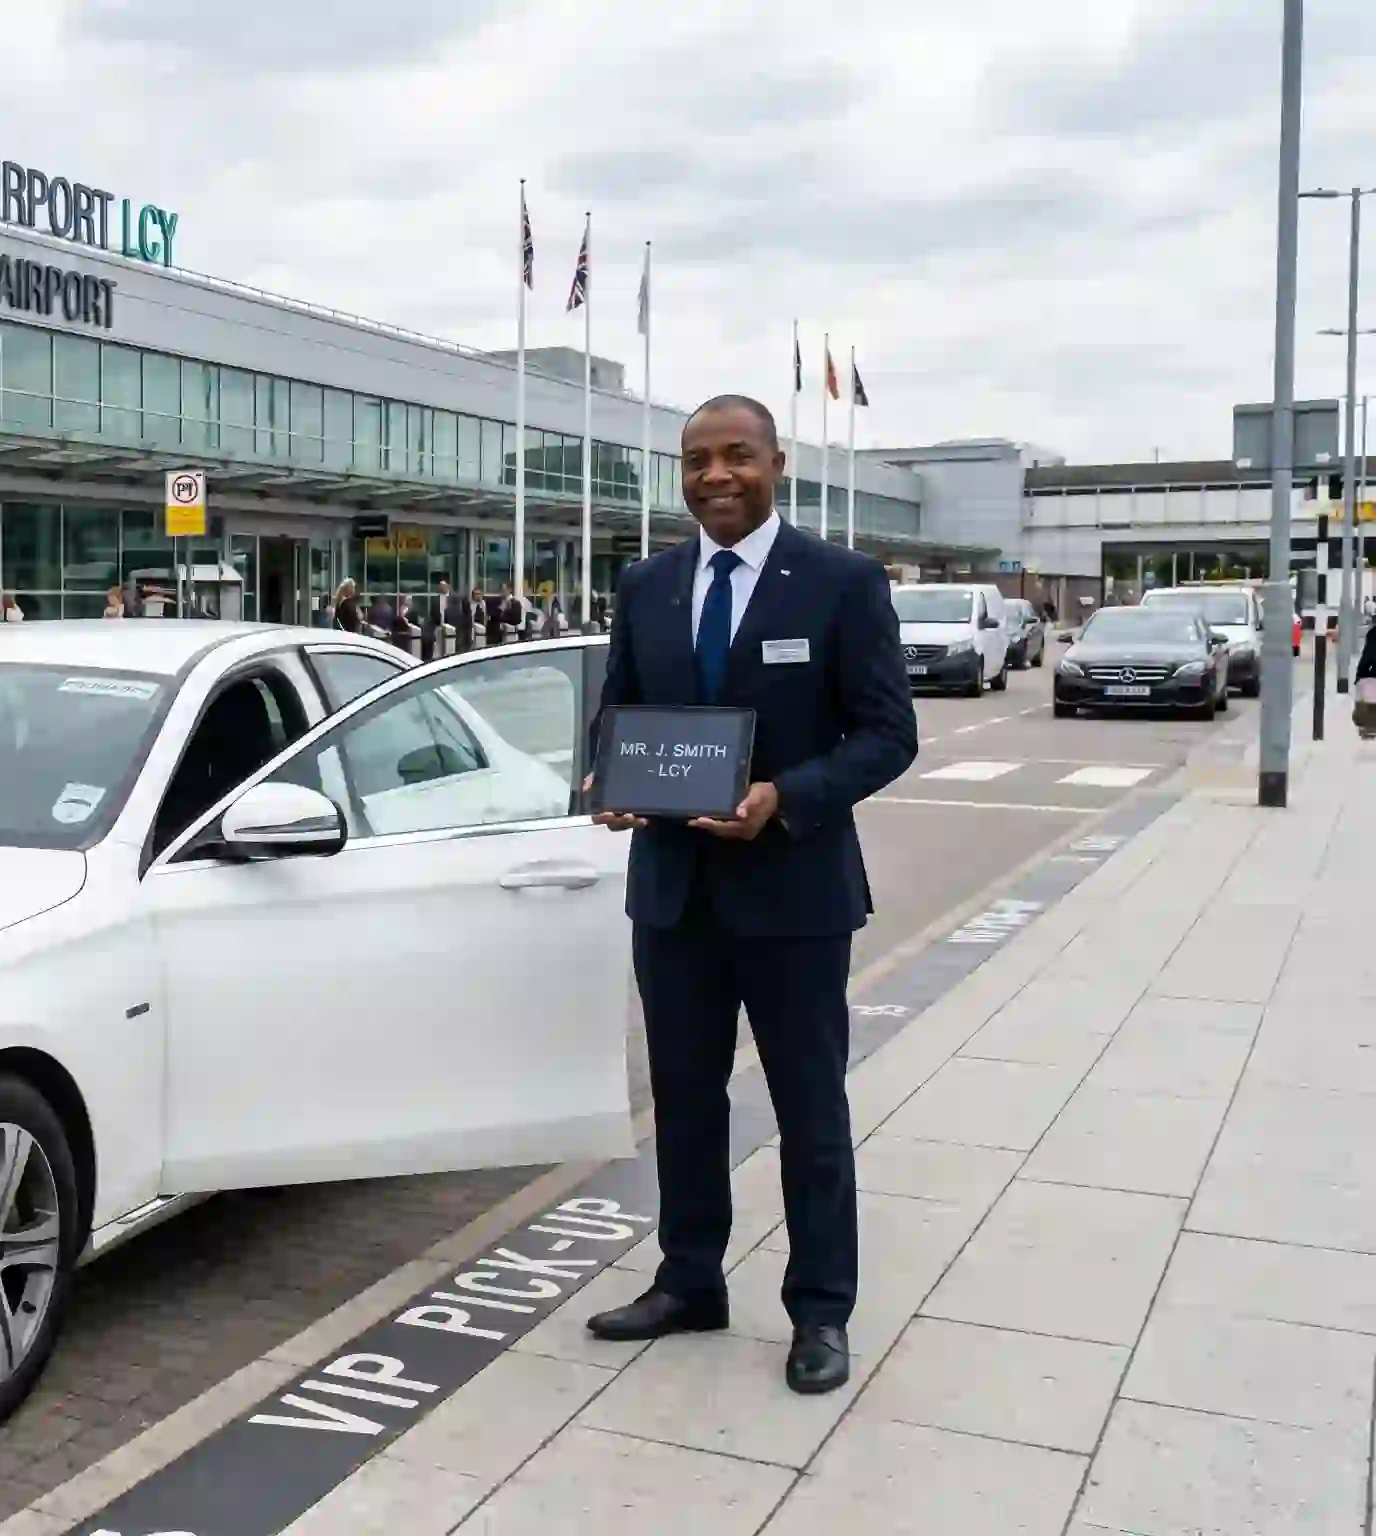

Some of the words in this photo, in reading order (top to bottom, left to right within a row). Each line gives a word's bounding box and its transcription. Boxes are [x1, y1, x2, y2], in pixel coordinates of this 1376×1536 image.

[121, 197, 179, 268] LCY
[620, 742, 650, 757] MR.
[655, 743, 668, 758] J.
[673, 743, 728, 758] SMITH
[658, 763, 693, 778] LCY
[248, 1351, 441, 1437] VIP
[396, 1197, 653, 1341] PICK-UP
